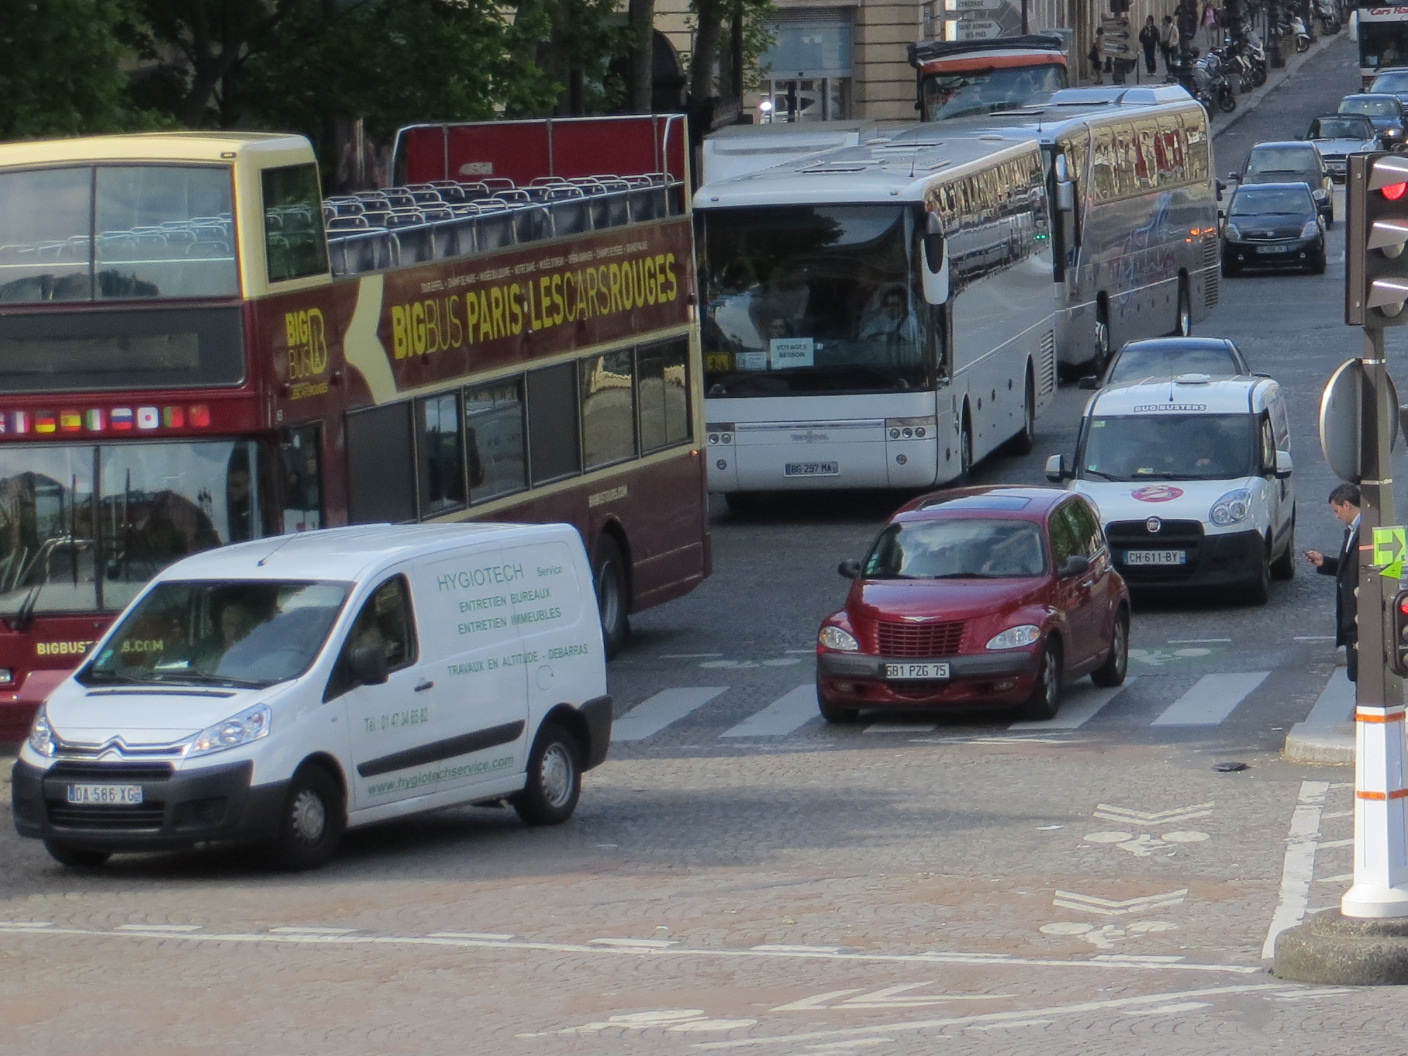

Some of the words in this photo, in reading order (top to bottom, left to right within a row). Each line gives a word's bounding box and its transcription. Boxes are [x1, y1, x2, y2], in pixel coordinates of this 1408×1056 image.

[1370, 7, 1391, 15] Cars
[285, 310, 309, 346] BIG
[391, 295, 463, 360] BIGBUS
[289, 346, 311, 379] BUS
[1133, 404, 1158, 412] BUG
[1158, 404, 1207, 412] BUSTERS
[436, 563, 525, 592] HYGIOTECH
[536, 565, 563, 577] Service
[458, 595, 507, 613] ENTRETIEN
[510, 587, 552, 605] BUREAUX
[457, 617, 507, 635] ENTRETIEN
[510, 607, 562, 626] IMMEUBLES
[447, 661, 485, 677] TRAVAUX
[488, 658, 499, 671] EN
[502, 651, 539, 667] ALTITUDE
[886, 665, 904, 677] 681
[909, 664, 929, 677] PZG
[932, 664, 947, 677] 75
[368, 755, 514, 793] www.hygiotechservice.com
